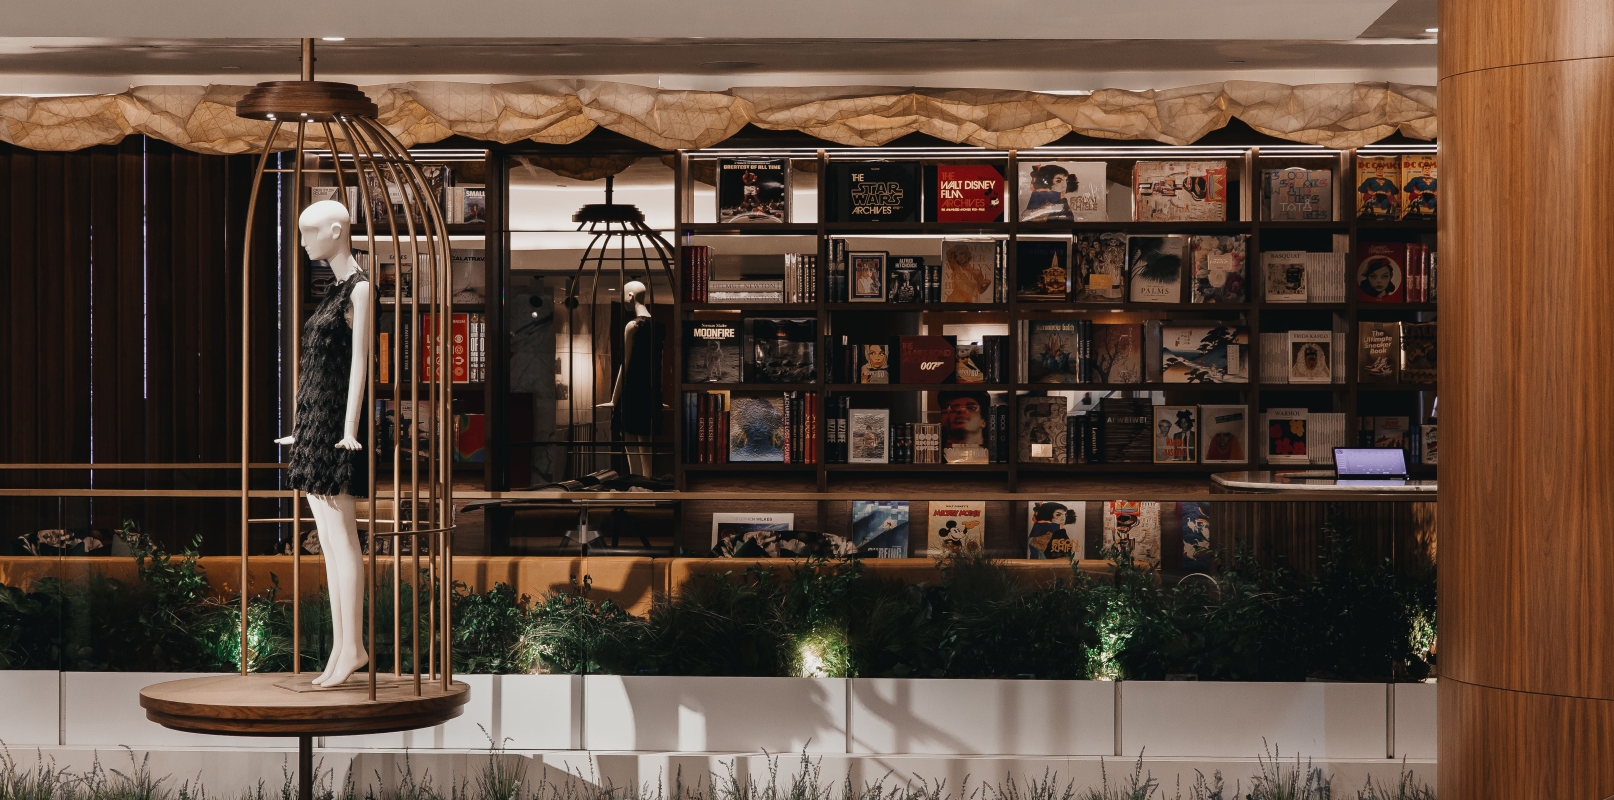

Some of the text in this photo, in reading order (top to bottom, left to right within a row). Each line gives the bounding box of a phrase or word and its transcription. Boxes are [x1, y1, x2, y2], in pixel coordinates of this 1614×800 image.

[851, 173, 865, 182] THE
[941, 171, 955, 180] THE
[851, 181, 904, 195] STAR
[940, 180, 996, 190] WALT DISNEY
[940, 189, 964, 199] FILM
[851, 193, 904, 206] WARS
[941, 198, 986, 208] ARCHIVES
[851, 206, 892, 215] ARCHIVES
[1140, 287, 1170, 295] PALMS
[693, 328, 735, 338] MOONFIRE
[1364, 336, 1393, 344] Ultimate
[929, 349, 952, 357] BOND
[920, 361, 945, 371] 007
[1106, 416, 1115, 424] AI
[933, 509, 981, 517] MICKEY MOUSE
